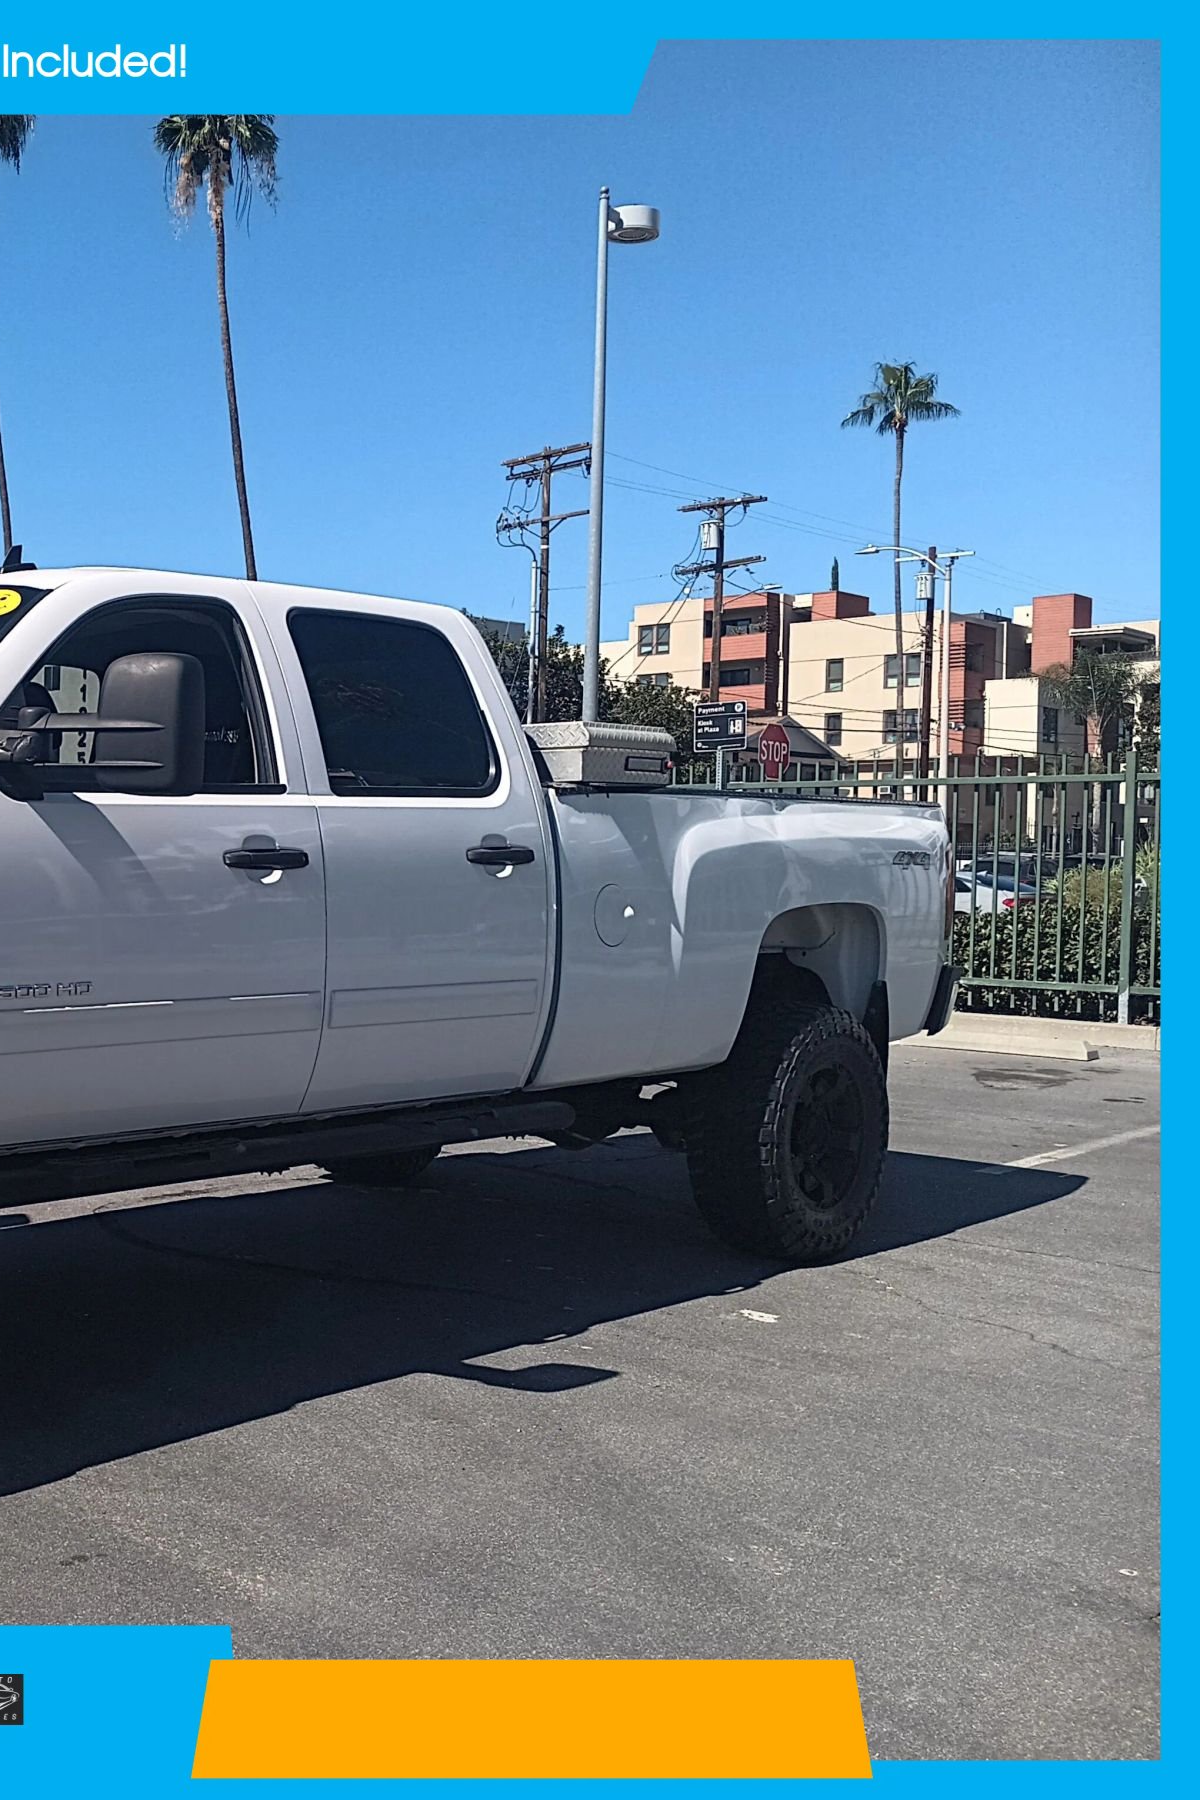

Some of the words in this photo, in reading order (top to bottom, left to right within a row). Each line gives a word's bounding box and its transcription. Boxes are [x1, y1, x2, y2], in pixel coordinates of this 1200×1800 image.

[698, 706, 725, 714] Payment
[761, 740, 788, 762] STOP
[57, 981, 93, 997] HD
